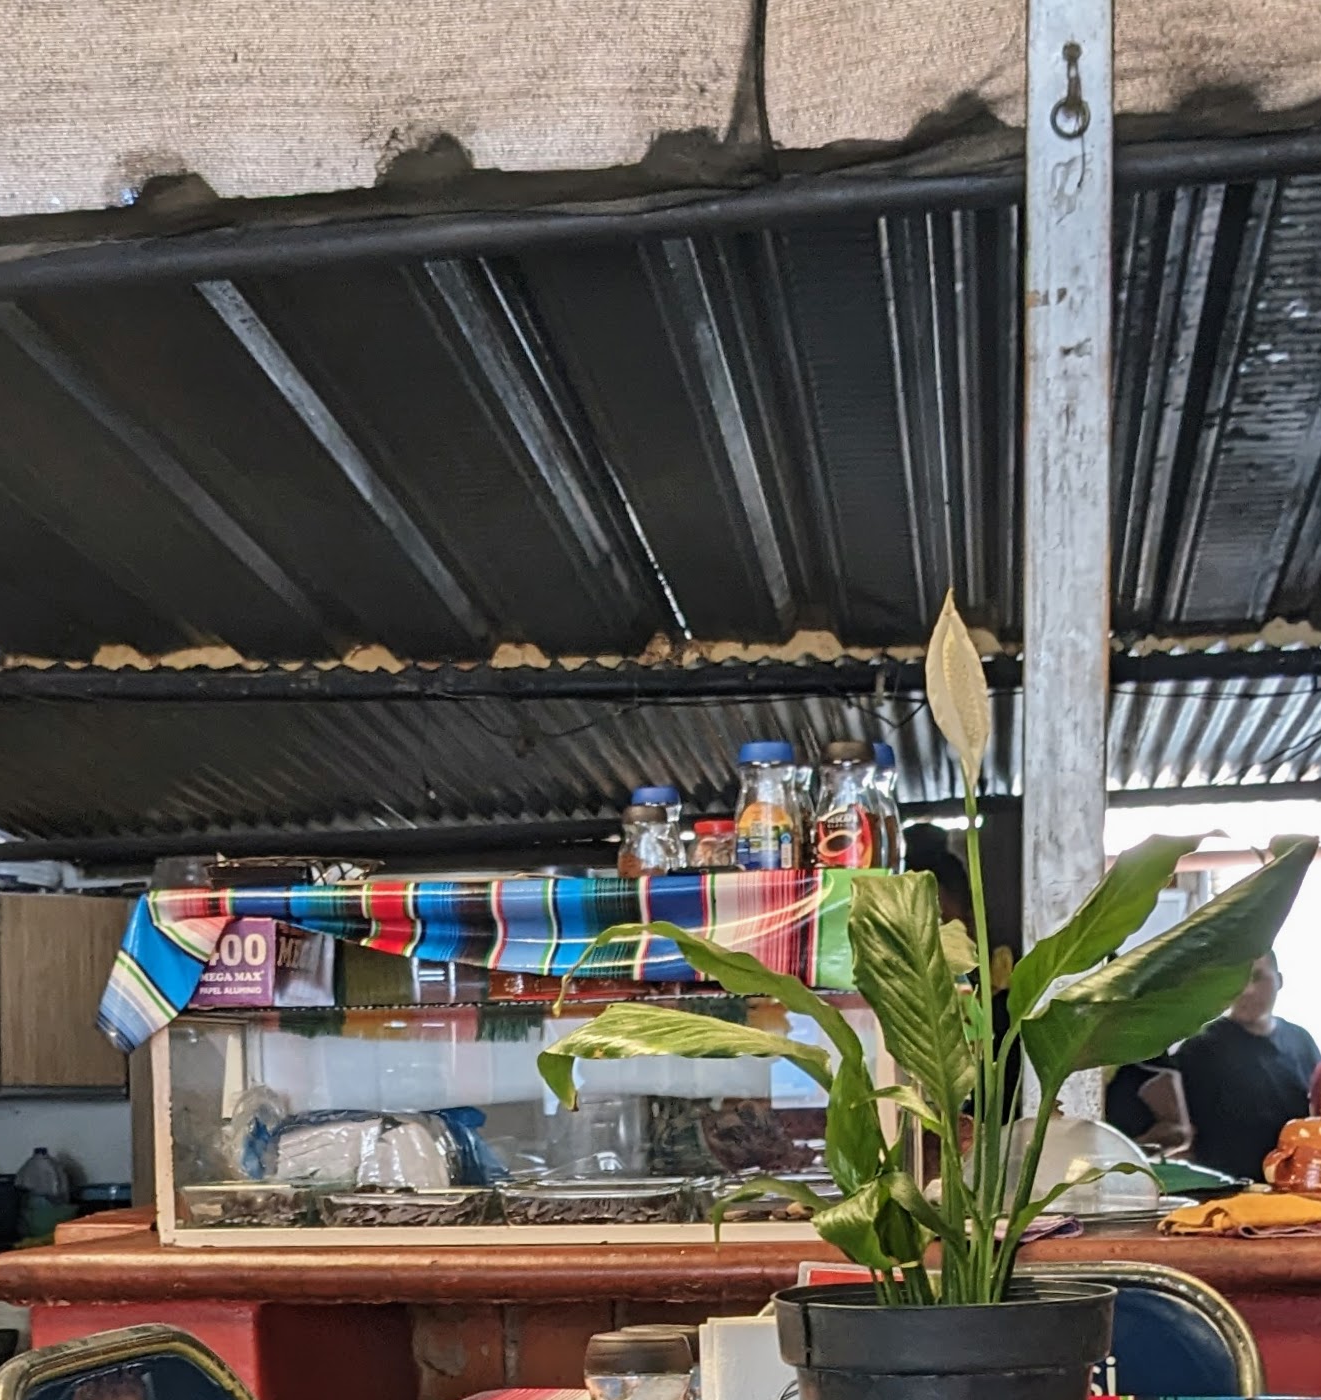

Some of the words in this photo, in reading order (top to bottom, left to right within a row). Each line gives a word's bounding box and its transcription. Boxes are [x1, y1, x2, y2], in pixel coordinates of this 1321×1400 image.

[201, 971, 233, 982] MEGA
[235, 971, 262, 982] MAX
[199, 987, 222, 995] PAPEL
